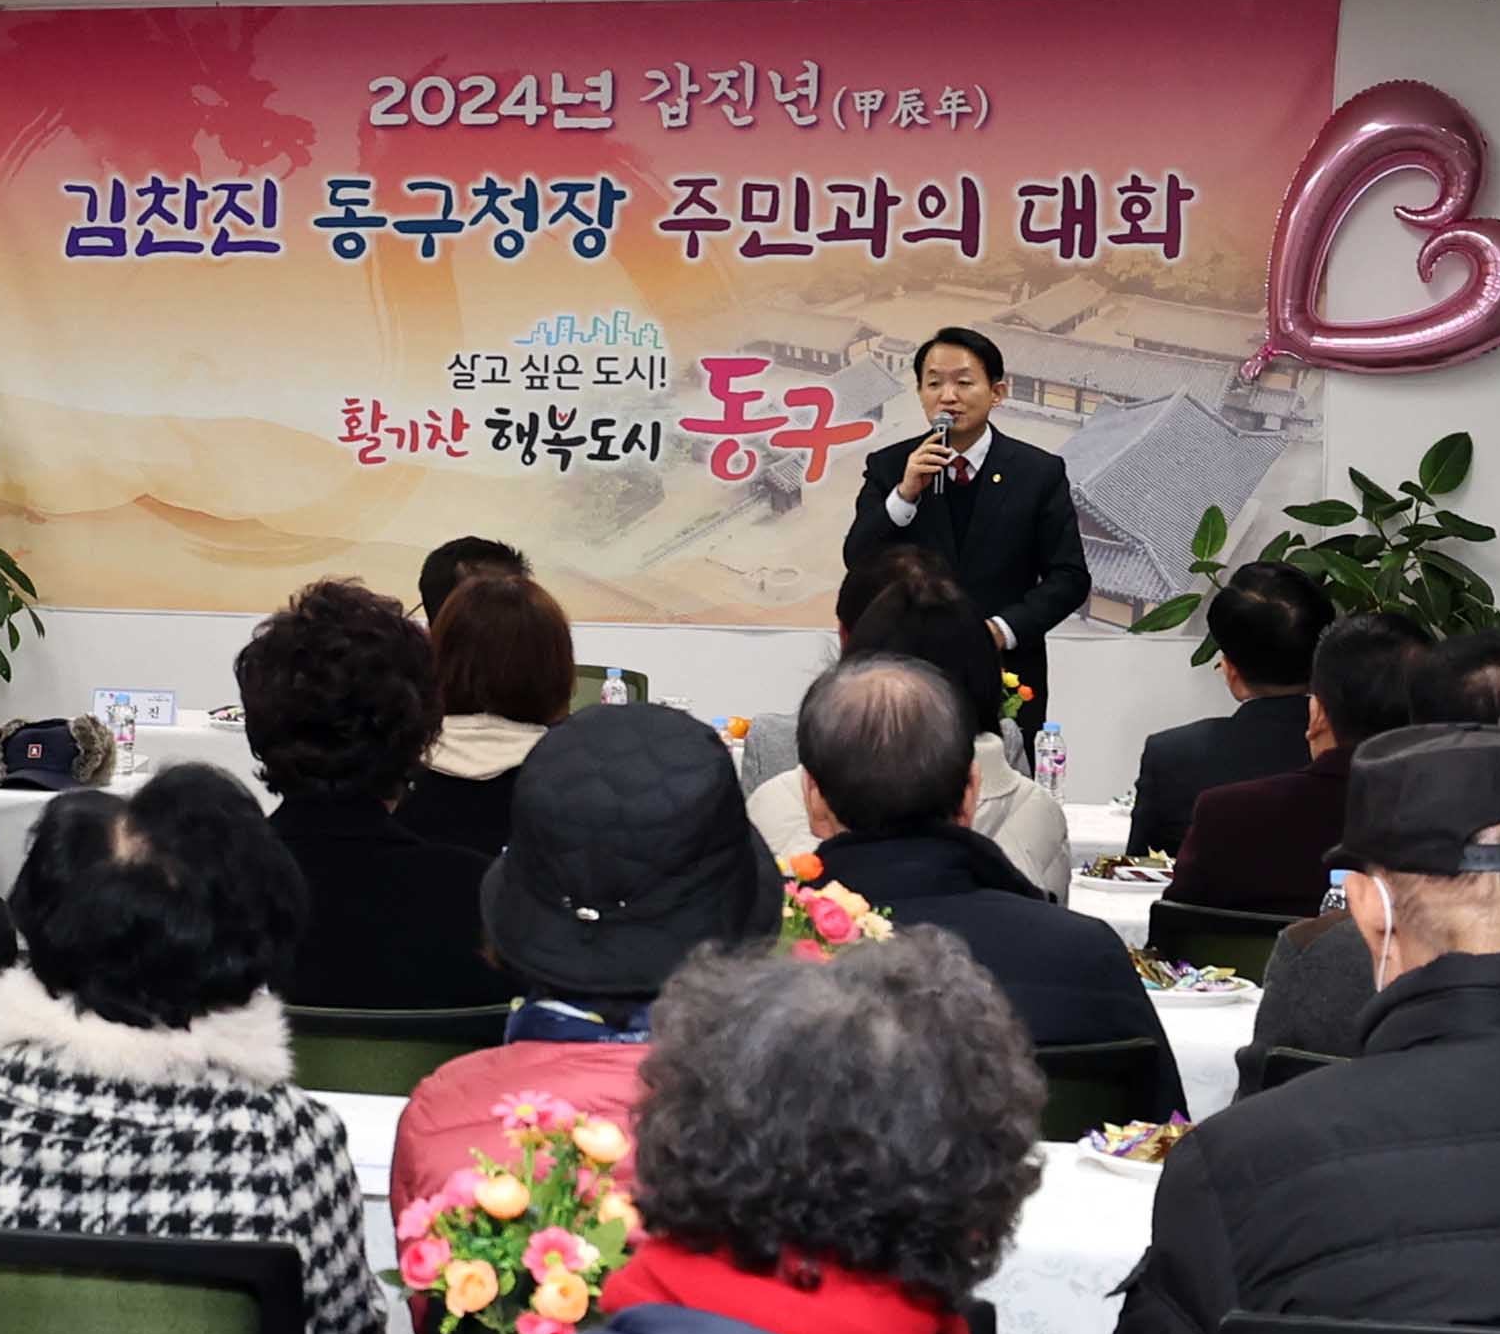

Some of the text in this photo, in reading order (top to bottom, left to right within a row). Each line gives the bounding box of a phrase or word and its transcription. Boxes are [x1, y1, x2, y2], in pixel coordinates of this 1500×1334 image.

[368, 67, 615, 130] 2024년
[64, 174, 1196, 261] 김찬진 동구청장 주민과의 대화
[446, 352, 668, 391] 살고 싶은 도시!
[337, 357, 875, 484] 활기찬 행복도시 동구
